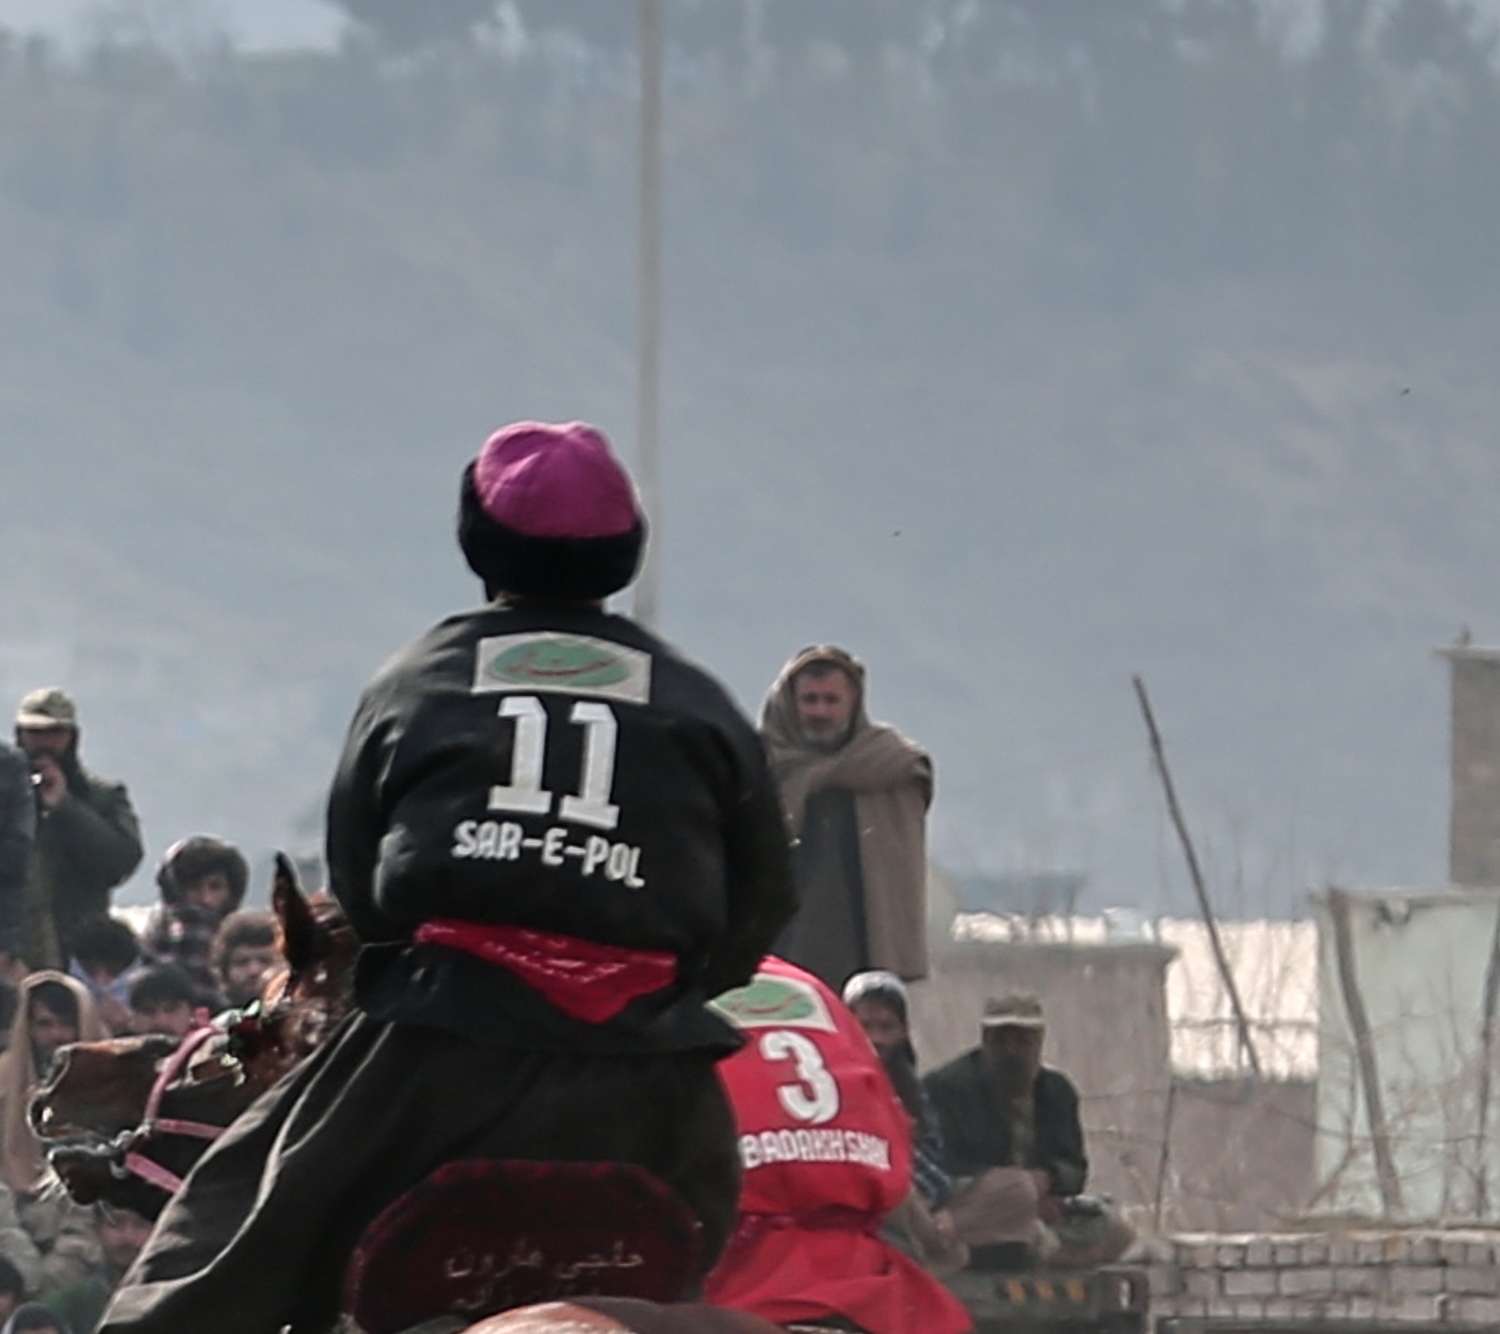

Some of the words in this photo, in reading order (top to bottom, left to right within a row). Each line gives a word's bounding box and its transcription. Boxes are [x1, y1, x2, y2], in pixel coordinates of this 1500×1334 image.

[486, 696, 620, 831] 11
[451, 820, 645, 888] SAR-E-POL
[759, 1030, 840, 1124] 3
